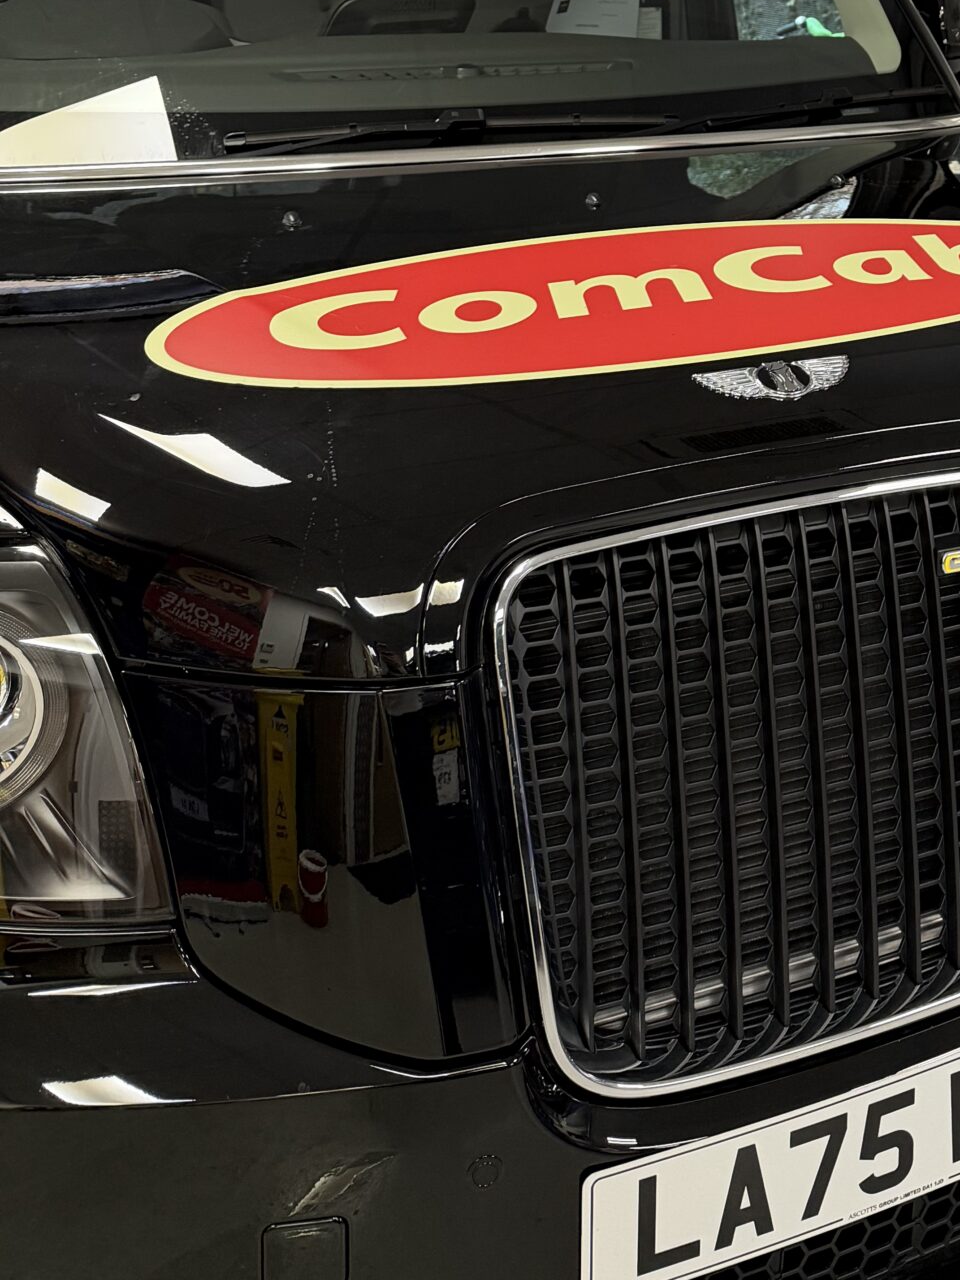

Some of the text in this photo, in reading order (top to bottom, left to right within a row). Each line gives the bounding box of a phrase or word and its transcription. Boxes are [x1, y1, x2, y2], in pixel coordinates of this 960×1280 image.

[637, 1088, 916, 1277] LA75
[848, 1205, 877, 1220] ASCOTTS
[878, 1197, 899, 1208] GROUP
[900, 1188, 921, 1200] LIMITED
